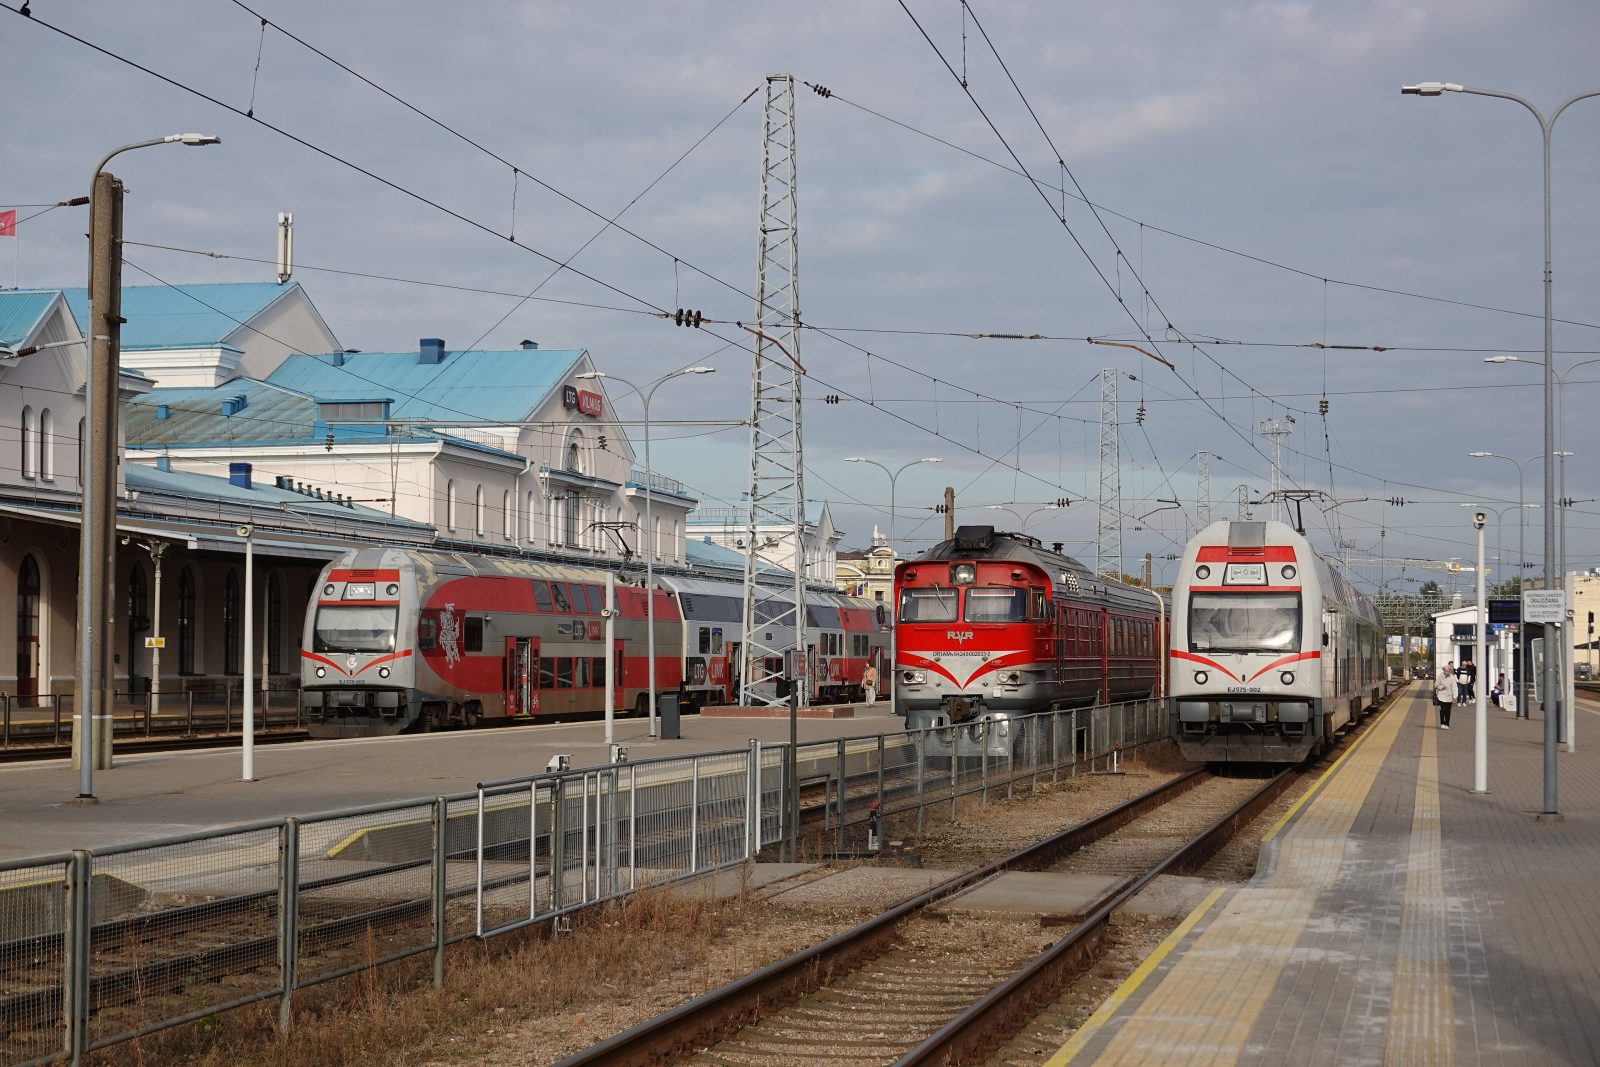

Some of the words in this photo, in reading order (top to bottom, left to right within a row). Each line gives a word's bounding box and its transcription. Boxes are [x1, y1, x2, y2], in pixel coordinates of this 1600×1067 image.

[566, 390, 576, 404] LTG
[582, 395, 601, 411] VILNIUS
[574, 624, 583, 636] LTG
[588, 625, 600, 636] LINK
[947, 631, 974, 645] RVR
[694, 663, 704, 679] LTG
[711, 663, 724, 679] LINK
